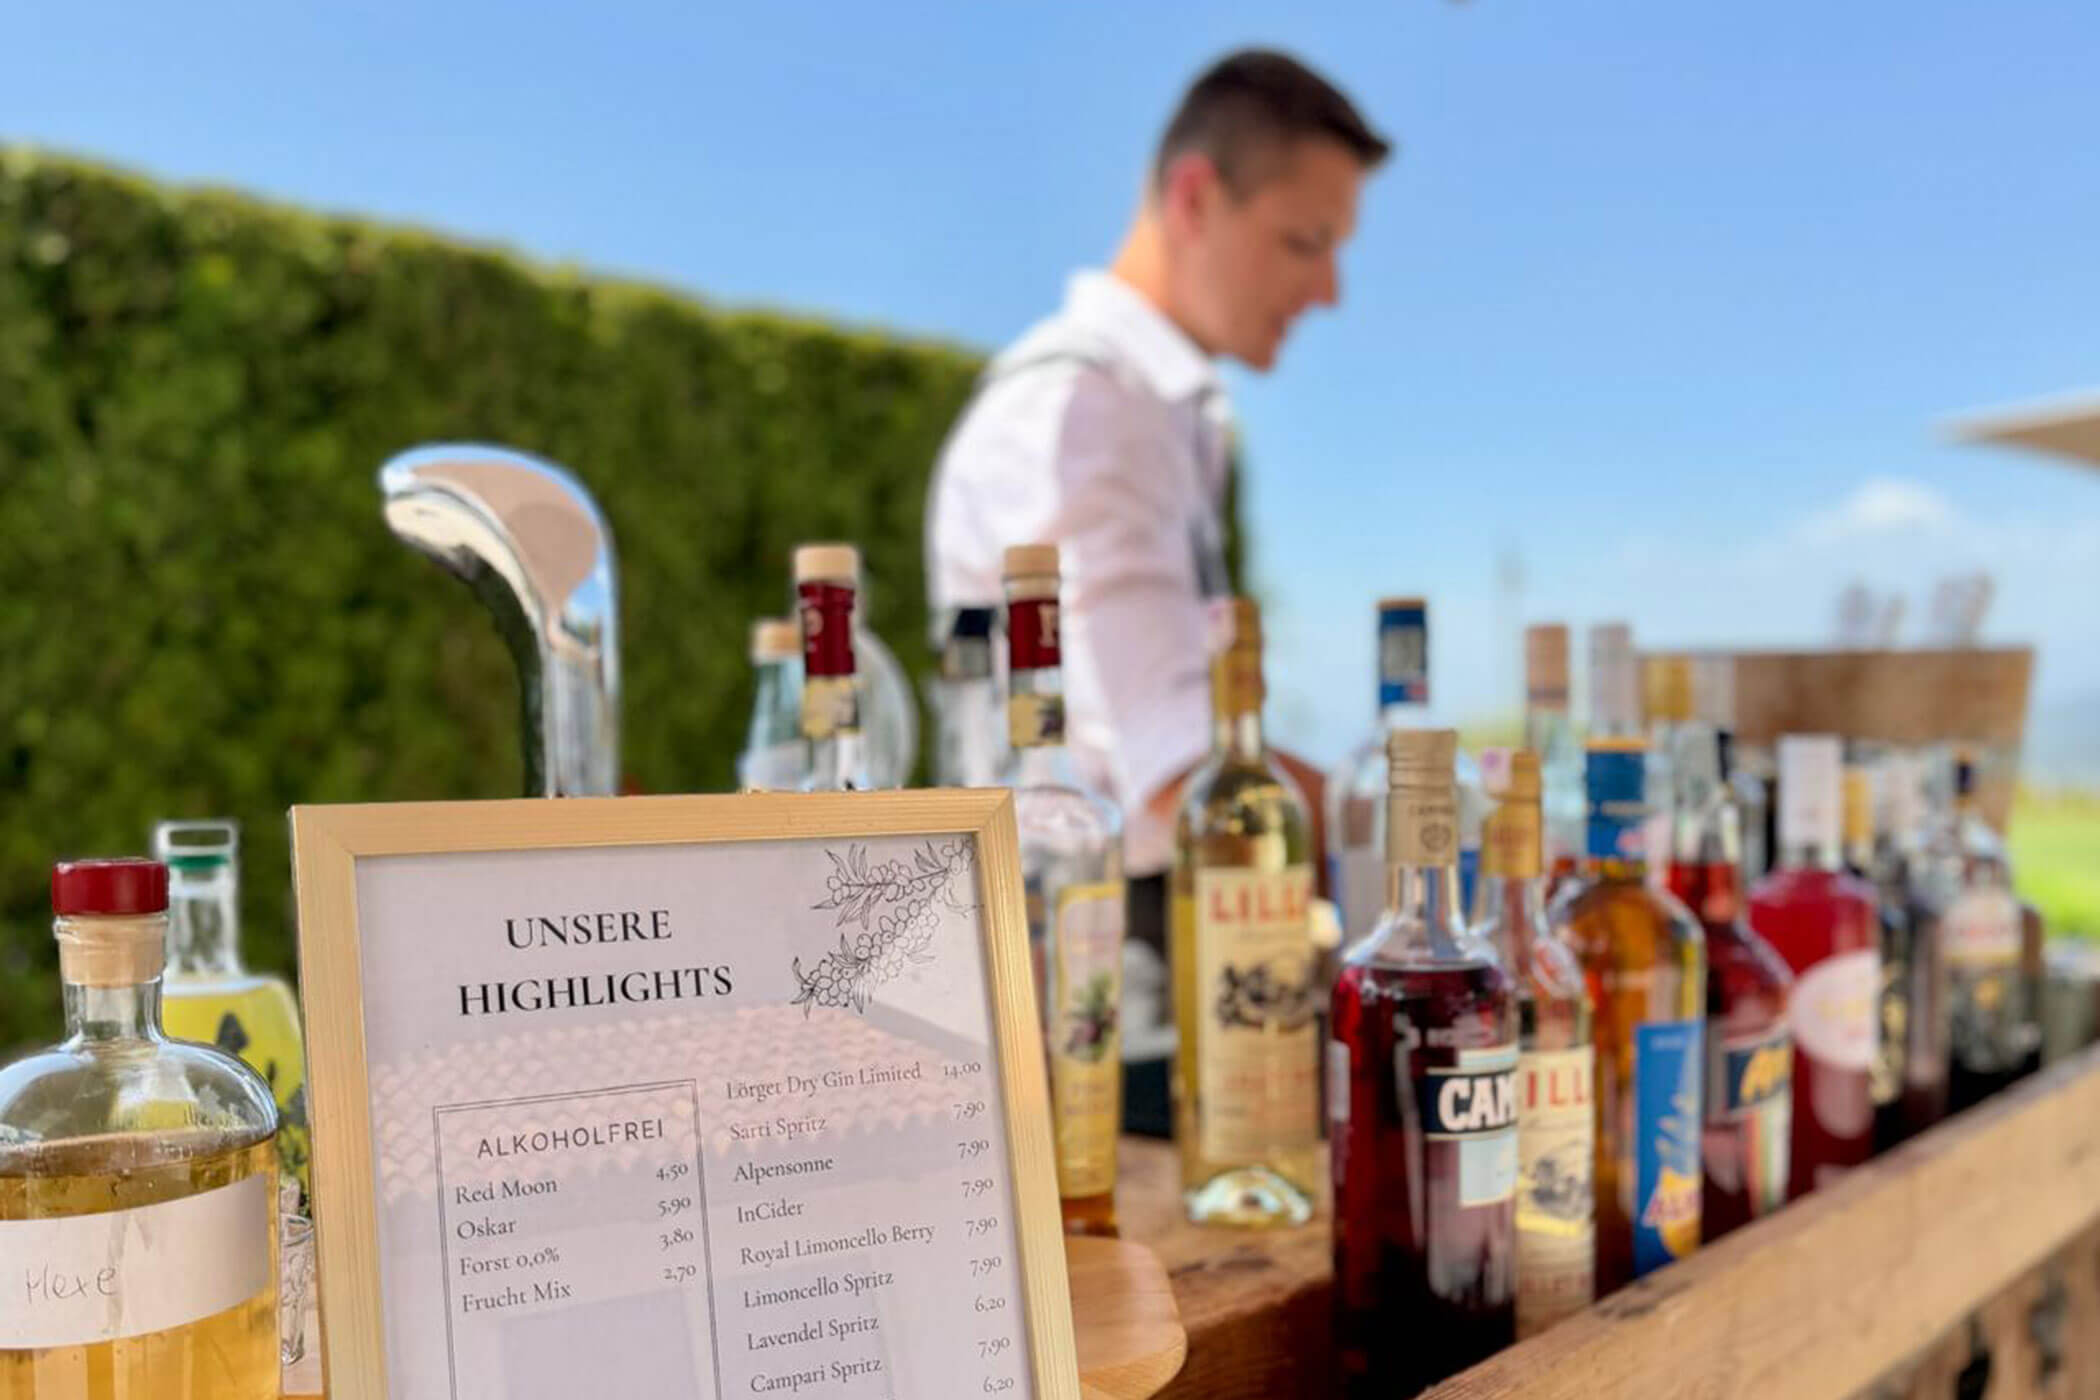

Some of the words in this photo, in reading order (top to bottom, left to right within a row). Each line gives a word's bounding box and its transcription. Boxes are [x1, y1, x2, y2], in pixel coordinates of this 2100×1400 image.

[504, 909, 673, 949] UNSERE
[457, 965, 733, 1016] HIGHLIGHTS
[726, 1080, 781, 1103] Lörget
[787, 1074, 819, 1098] Dry
[823, 1070, 854, 1089] Gin
[859, 1061, 922, 1085] Limited
[476, 1118, 664, 1159] ALKOHOLFREI
[730, 1122, 772, 1141] Sarti
[776, 1115, 827, 1140] Spritz
[455, 1181, 495, 1204] Red
[501, 1178, 558, 1200] Moon
[655, 1162, 689, 1182] 4,50
[733, 1157, 834, 1185] Alpensonne
[957, 1139, 990, 1159] 7,90
[456, 1216, 518, 1240] Oskar
[657, 1196, 692, 1217] 5,90
[737, 1199, 805, 1224] InCider
[961, 1177, 994, 1197] 7,90
[459, 1256, 511, 1276] Forst
[515, 1246, 561, 1269] 0,0%
[659, 1228, 695, 1251] 3,80
[740, 1241, 791, 1268] Royal
[795, 1227, 888, 1257] Limoncello
[892, 1224, 936, 1244] Berry
[965, 1216, 999, 1237] 7,90
[462, 1287, 527, 1313] Frucht
[533, 1280, 573, 1302] Mix
[663, 1265, 697, 1283] 2,70
[743, 1276, 840, 1309] Limoncello
[844, 1270, 894, 1297] Spritz
[970, 1256, 1003, 1277] 7,90
[747, 1320, 824, 1351] Lavendel
[828, 1315, 880, 1342] Spritz
[974, 1295, 1006, 1313] 6,20
[750, 1366, 826, 1394] Campari
[831, 1359, 883, 1384] Spritz
